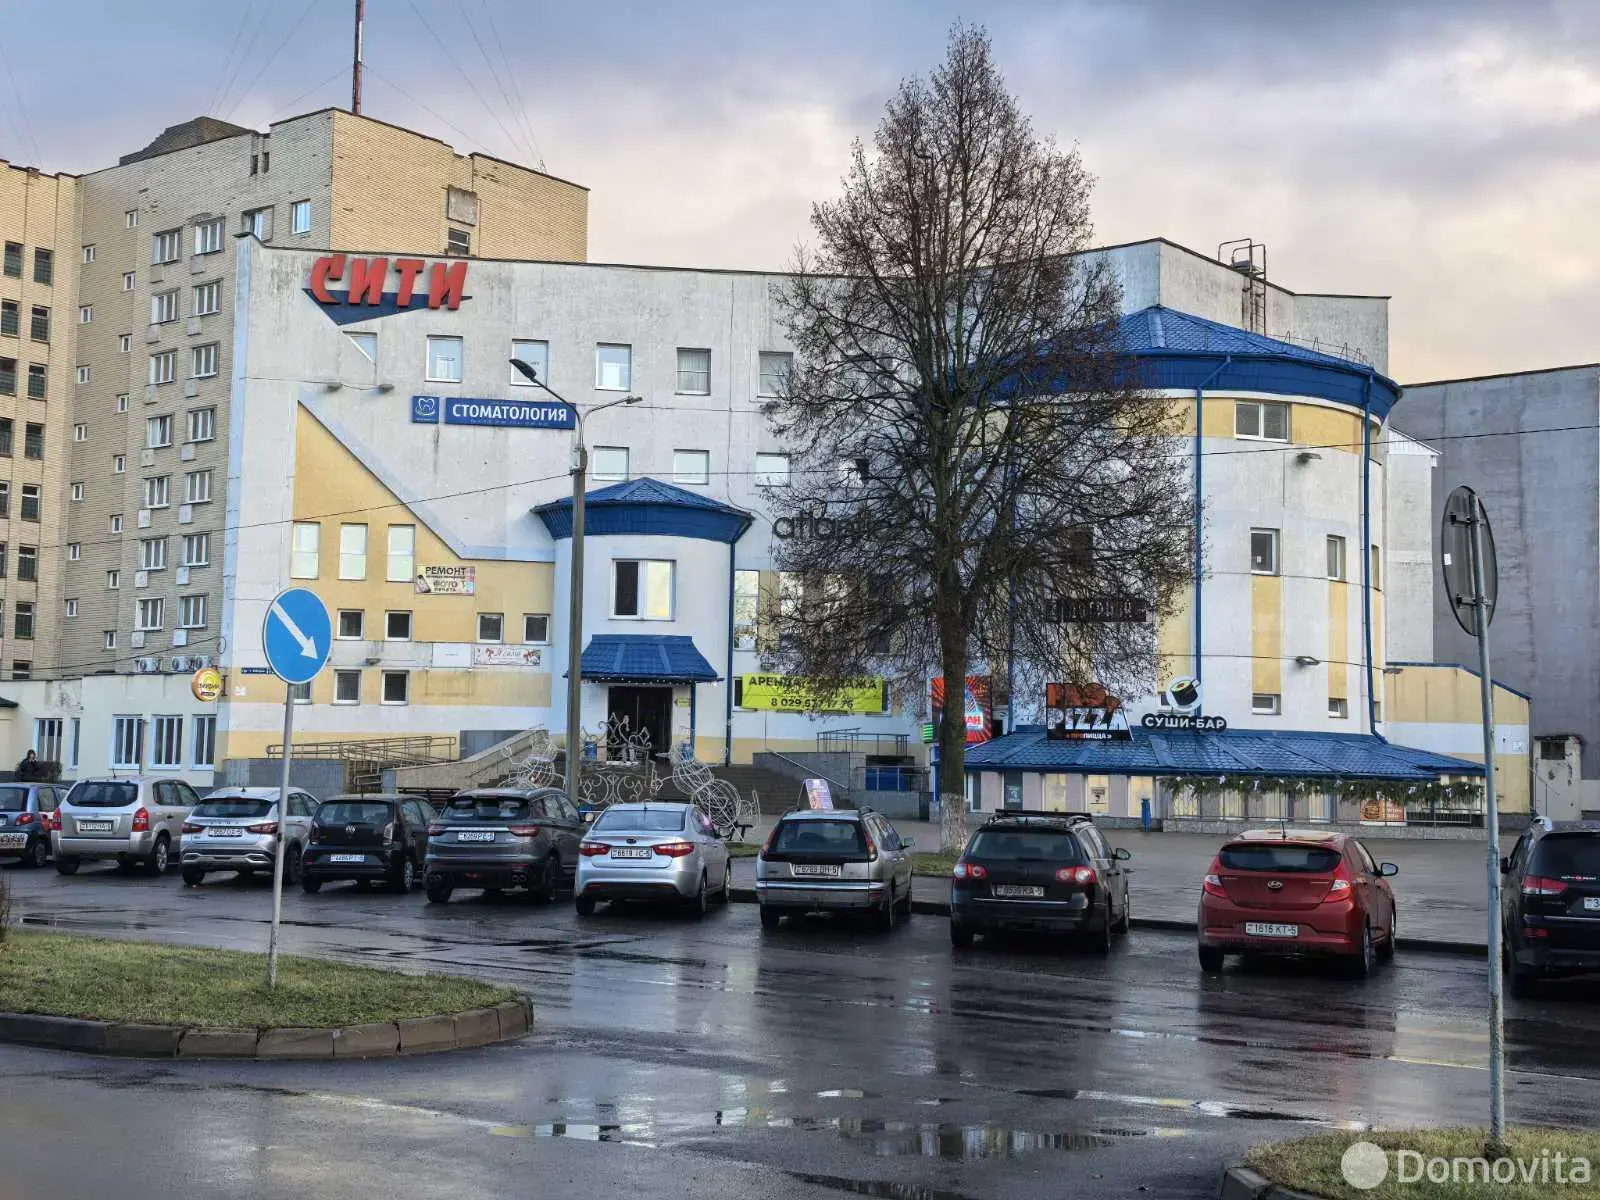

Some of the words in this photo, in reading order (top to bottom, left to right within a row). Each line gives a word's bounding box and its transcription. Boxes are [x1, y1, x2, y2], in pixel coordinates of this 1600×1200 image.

[310, 253, 469, 310] СИТИ
[452, 403, 567, 422] СТОМАТОЛОГИЯ
[425, 566, 466, 576] РЕМОНТ
[770, 697, 778, 707] 8
[781, 698, 802, 707] 029
[1047, 707, 1128, 730] PIZZA
[1144, 715, 1227, 731] СУШИ-БАР
